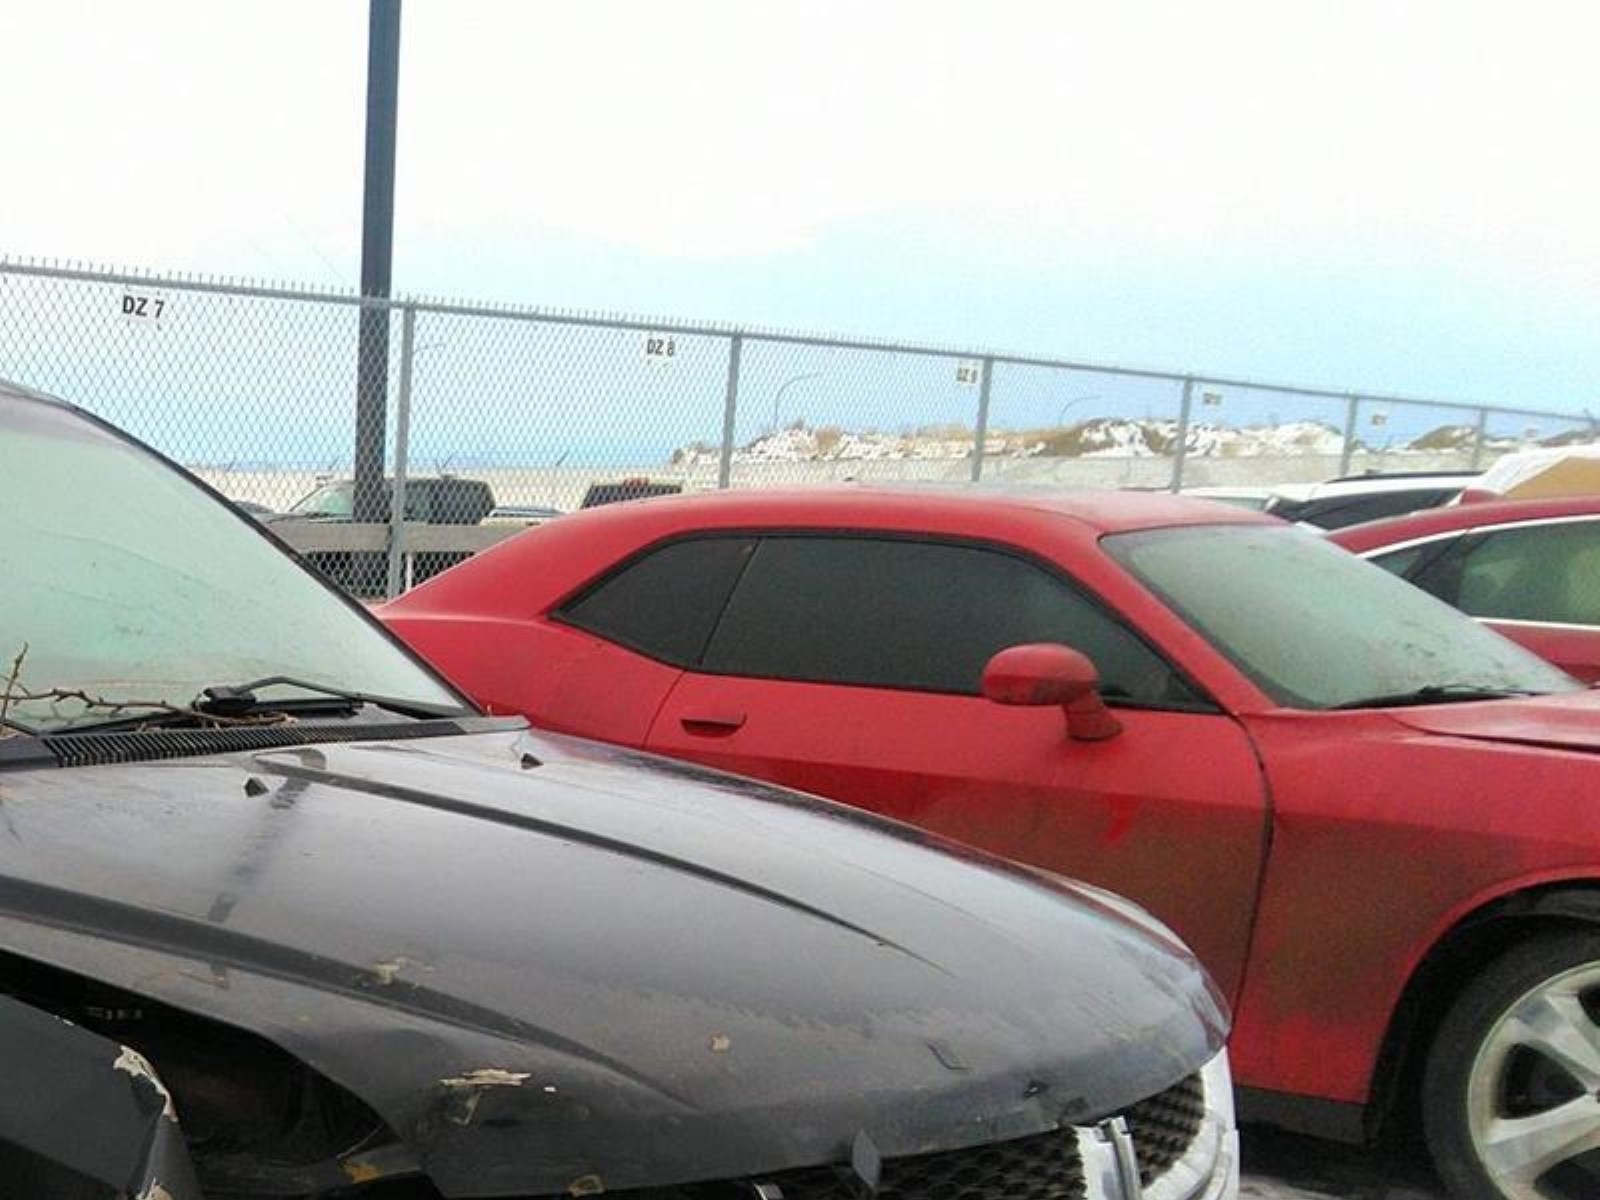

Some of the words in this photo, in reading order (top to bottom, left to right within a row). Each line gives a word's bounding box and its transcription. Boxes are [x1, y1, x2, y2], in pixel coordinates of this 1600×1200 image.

[122, 294, 148, 317] DZ
[154, 300, 165, 319] 7
[646, 338, 664, 356] DZ
